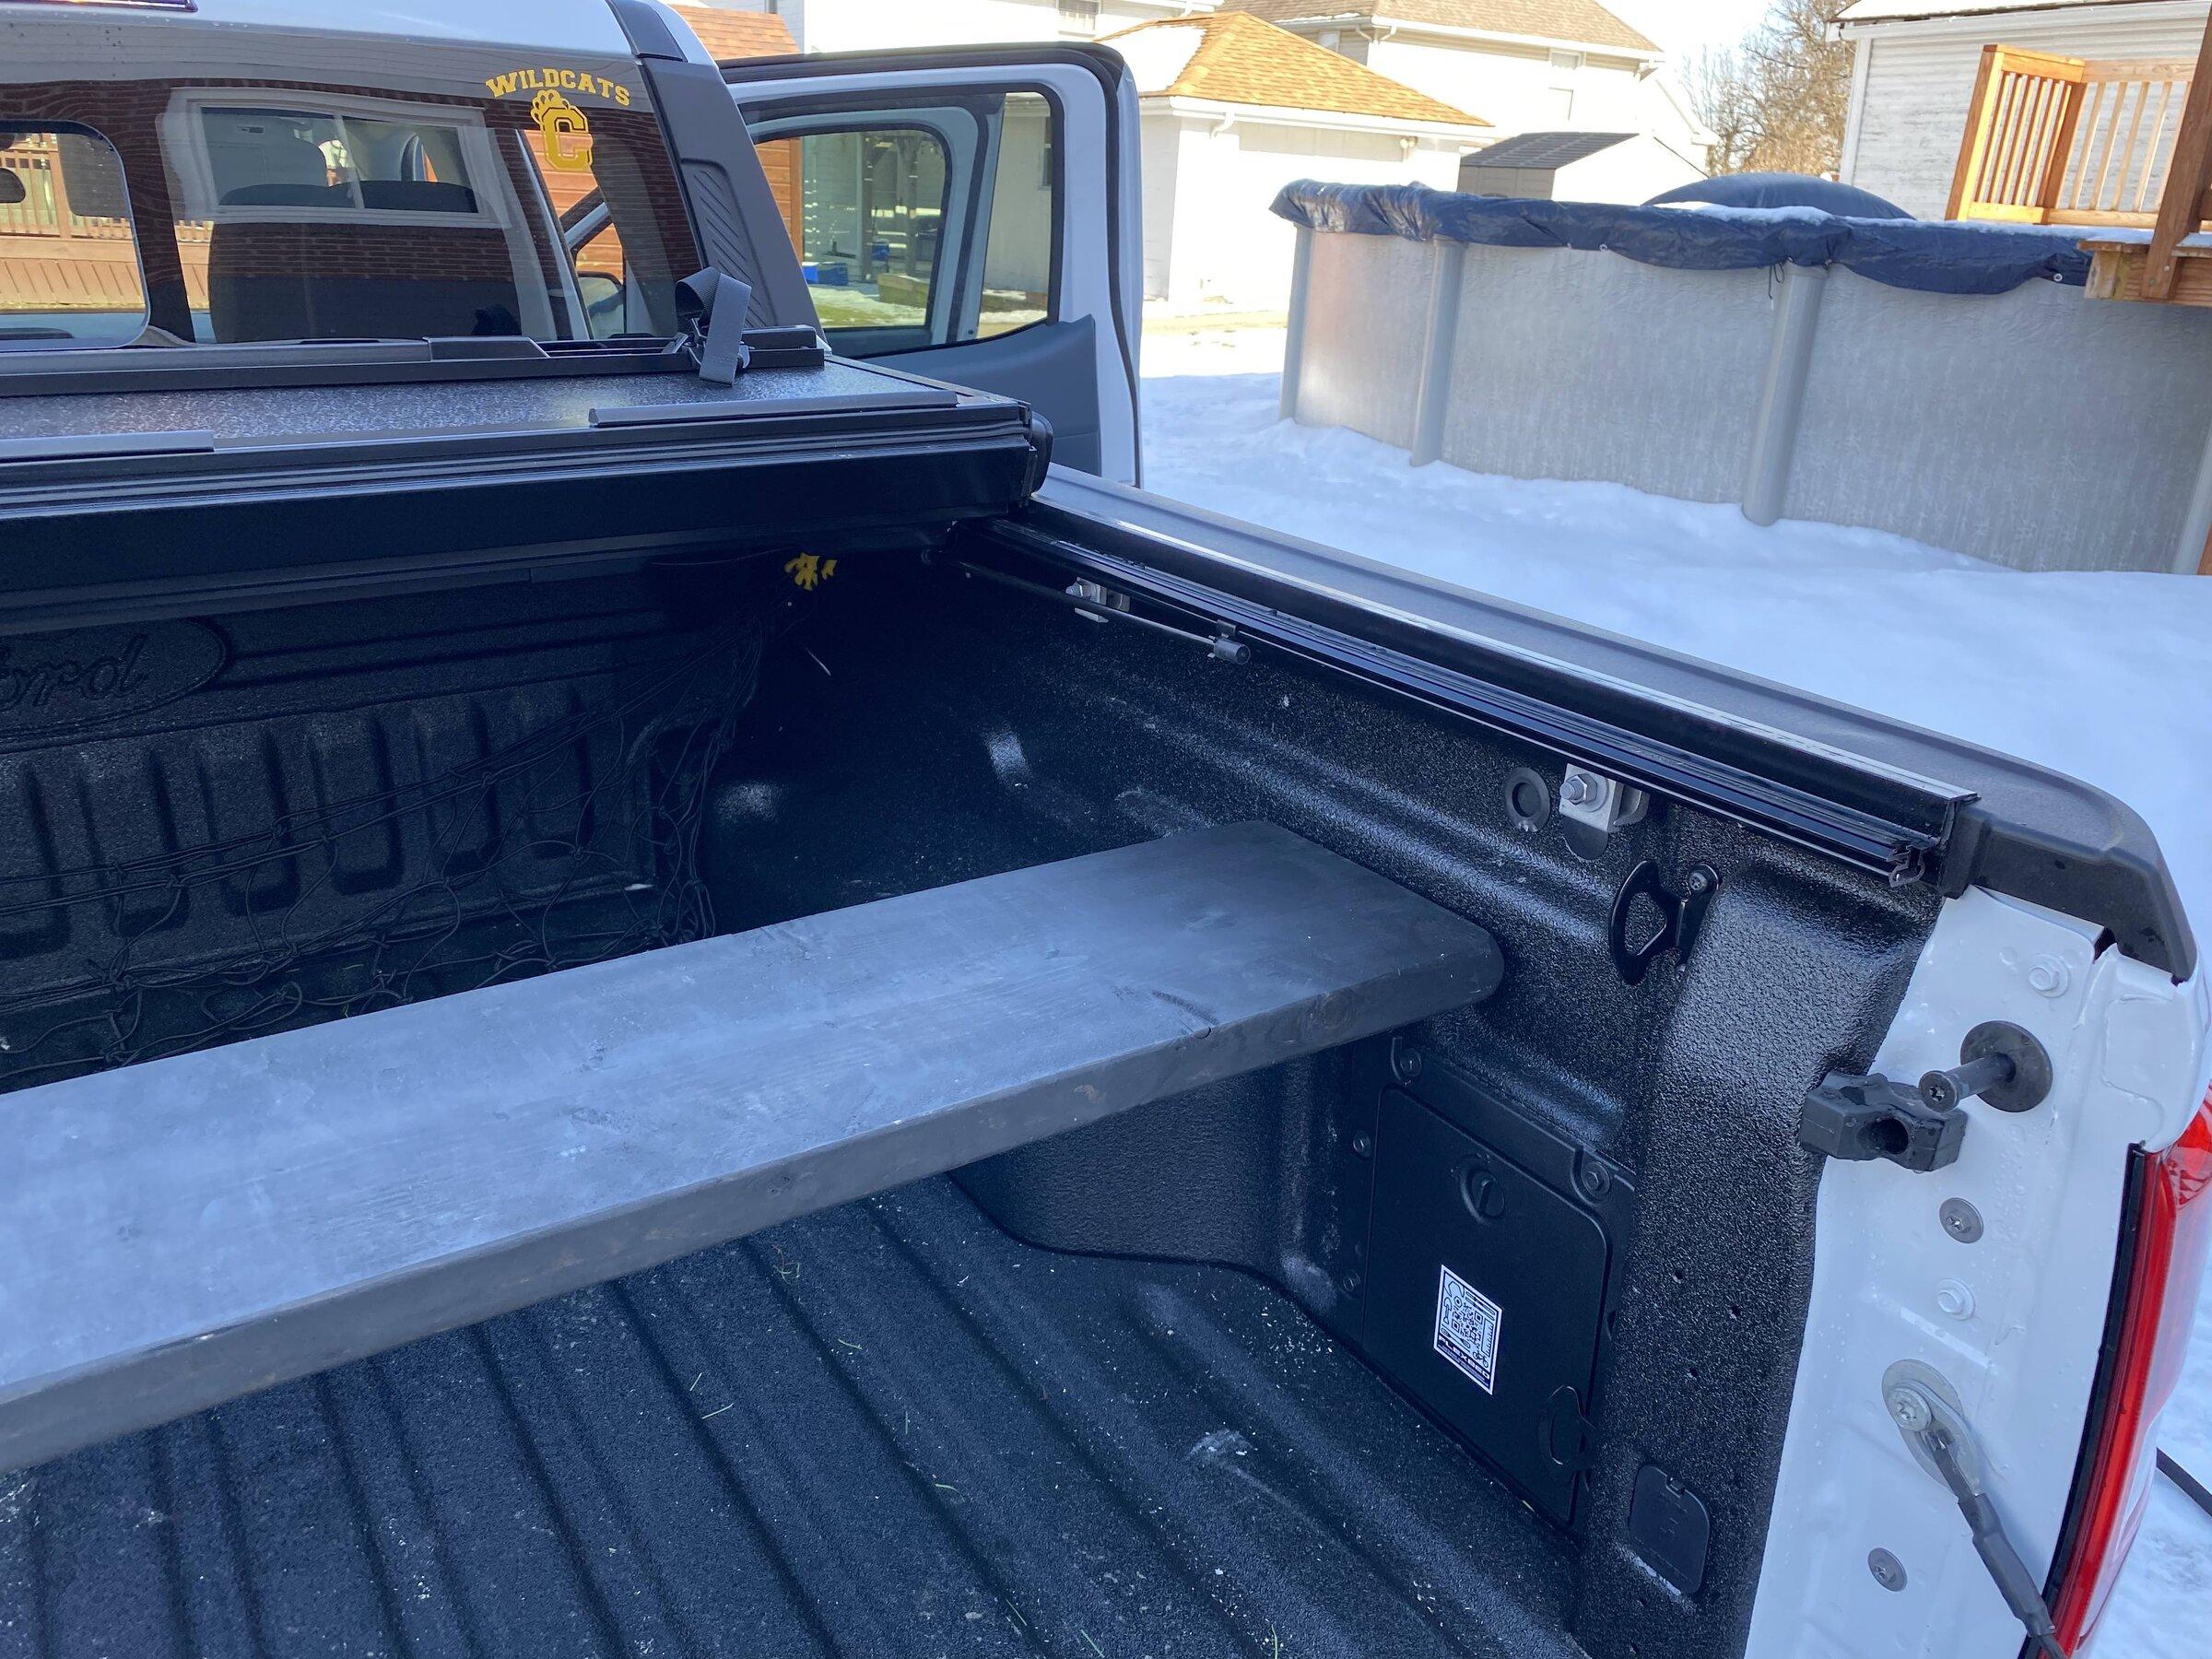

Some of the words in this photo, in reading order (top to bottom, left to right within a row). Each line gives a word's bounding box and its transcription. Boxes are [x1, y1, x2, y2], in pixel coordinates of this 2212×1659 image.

[486, 68, 630, 106] WILDCATS
[541, 108, 593, 172] C
[0, 632, 150, 712] ord
